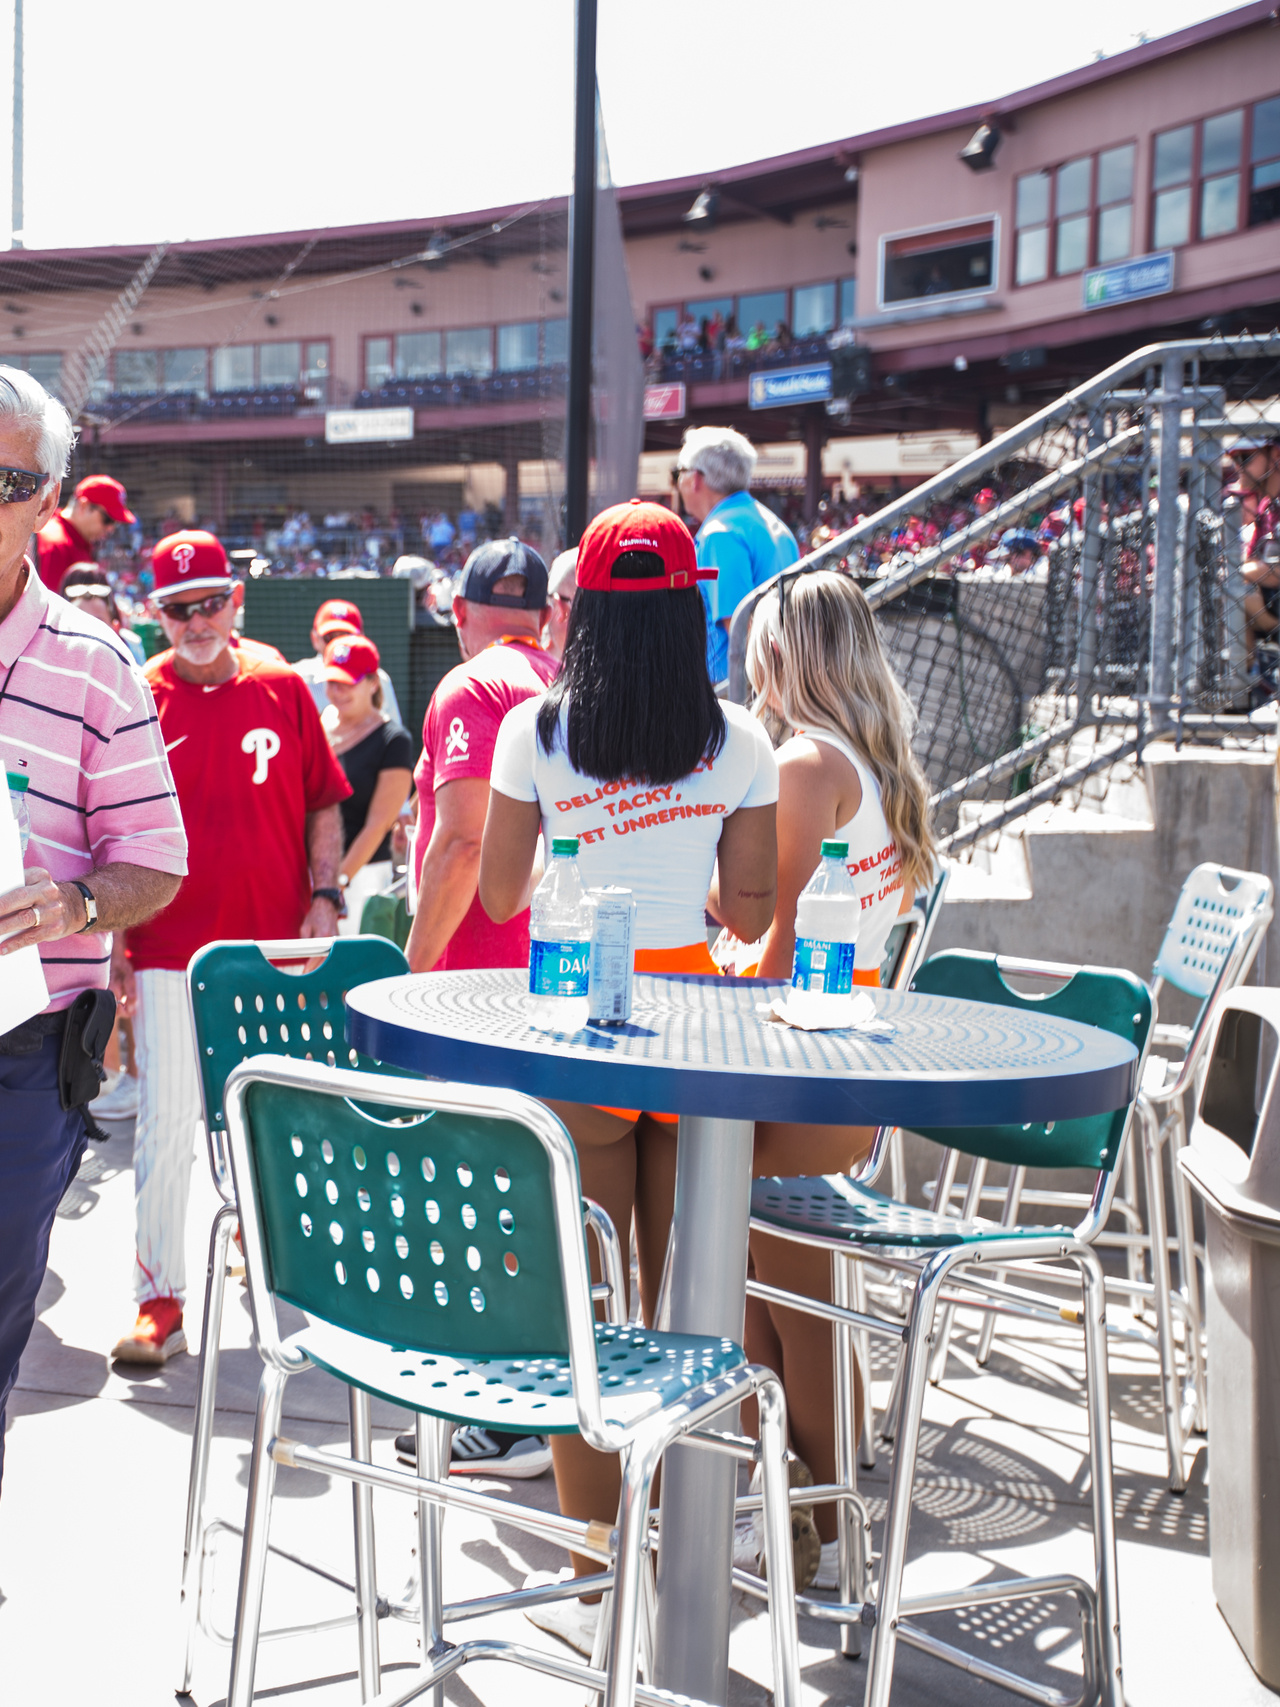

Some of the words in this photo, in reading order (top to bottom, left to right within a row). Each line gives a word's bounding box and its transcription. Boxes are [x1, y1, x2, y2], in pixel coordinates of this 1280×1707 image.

[172, 543, 195, 573] P
[241, 728, 281, 784] P
[603, 786, 682, 817] TACKY,
[612, 803, 729, 836] UNREFINED.
[803, 940, 831, 951] DASANI
[559, 954, 590, 976] DAS
